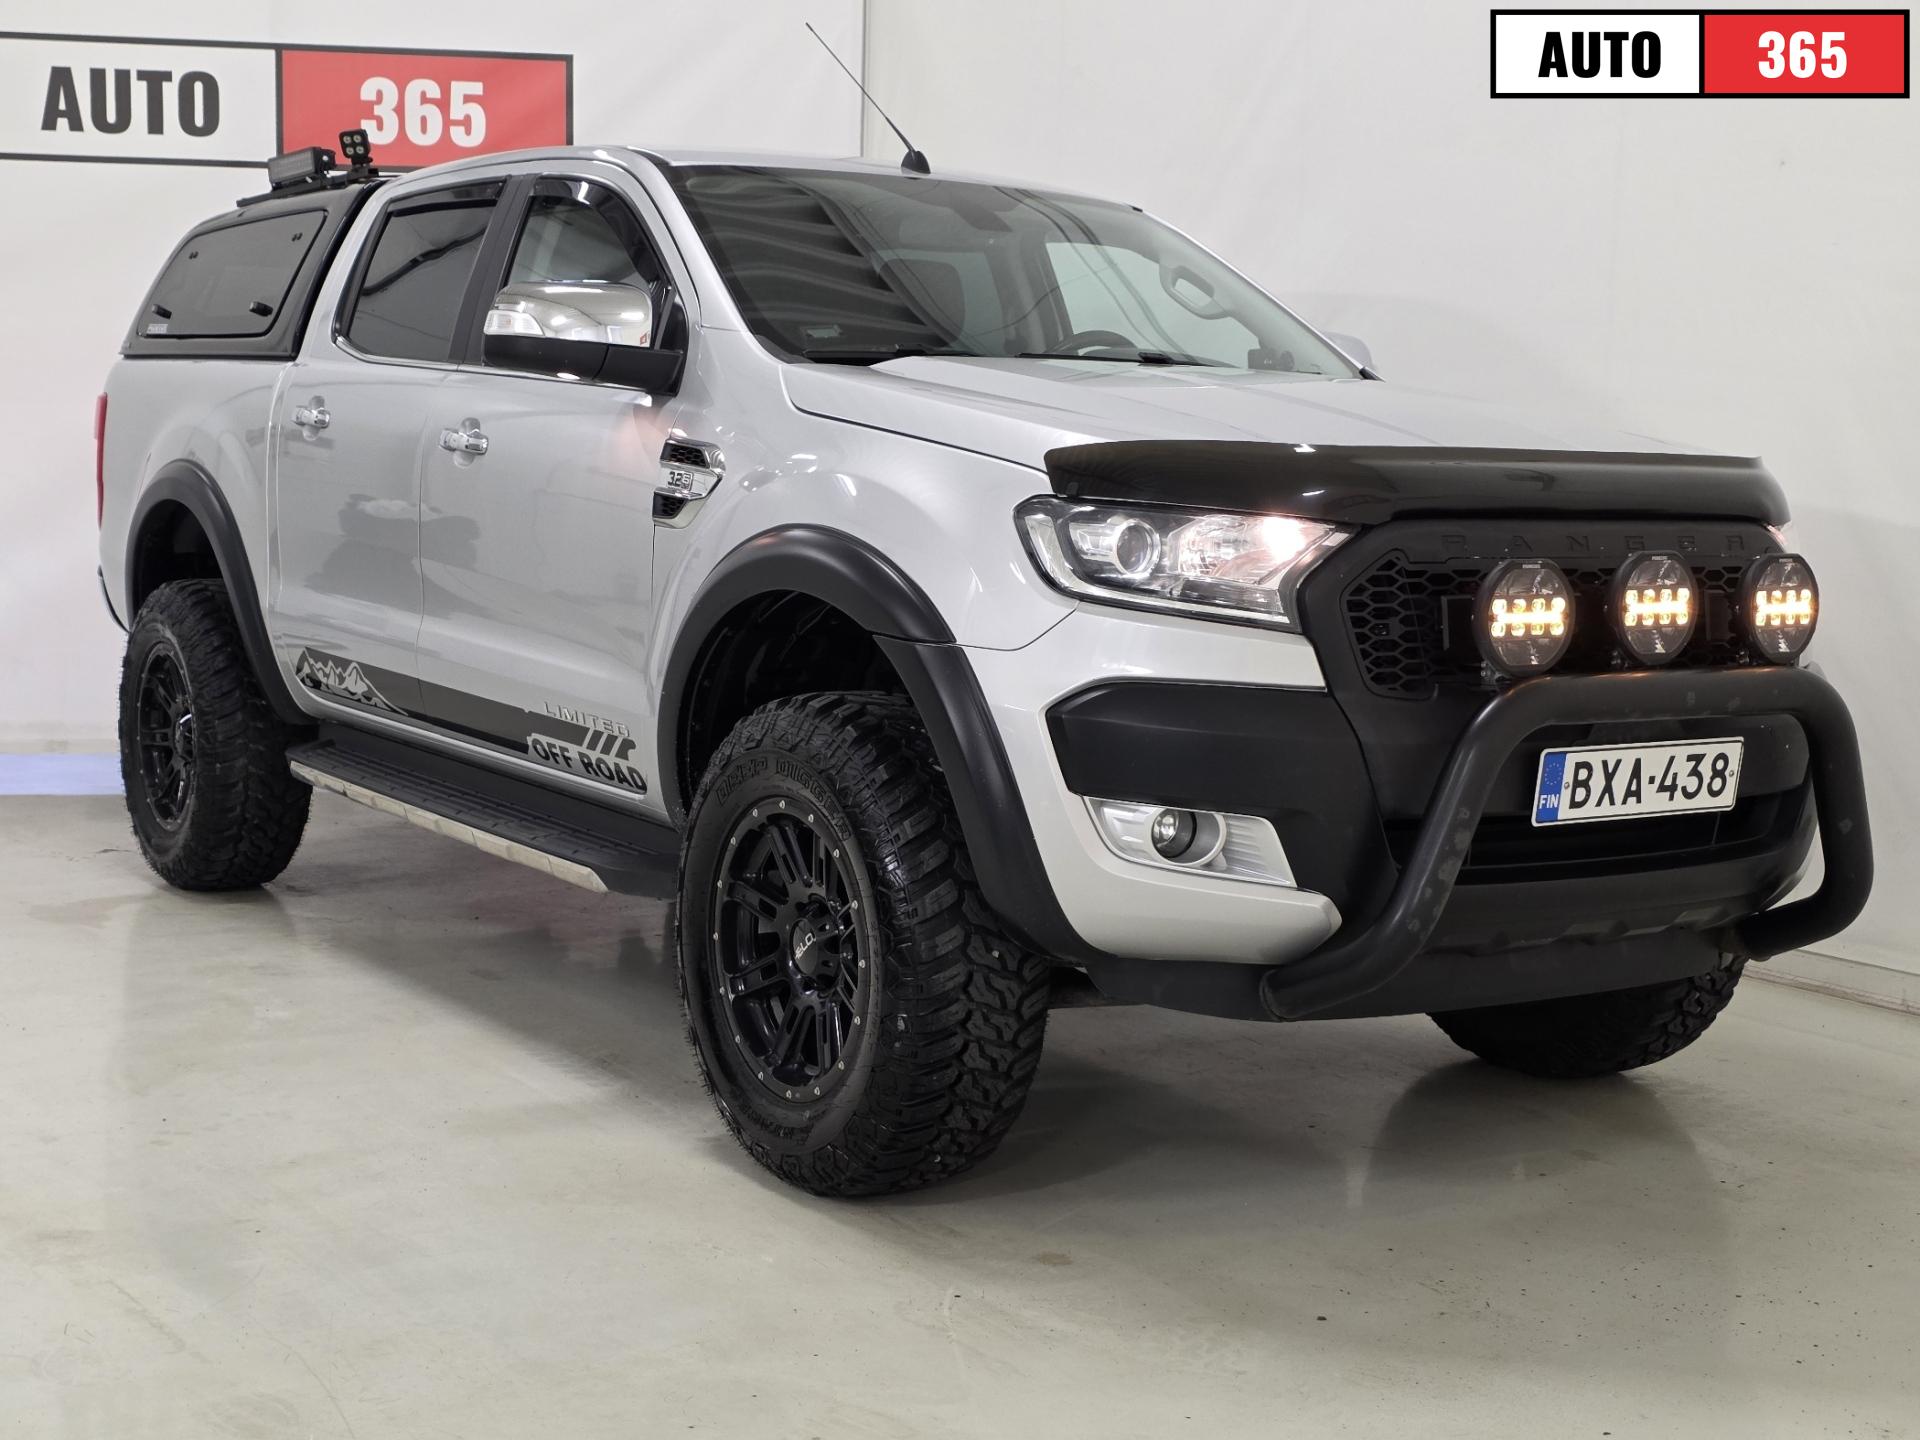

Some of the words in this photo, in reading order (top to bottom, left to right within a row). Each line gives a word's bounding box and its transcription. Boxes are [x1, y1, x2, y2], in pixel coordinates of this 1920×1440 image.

[41, 66, 220, 137] AUTO
[359, 77, 486, 147] 365
[1441, 534, 1745, 551] RANGER
[544, 701, 630, 737] LIMITED
[531, 738, 573, 768] OFF
[577, 751, 648, 795] ROAD
[1569, 752, 1730, 809] BXA-438
[1539, 793, 1560, 809] FIN
